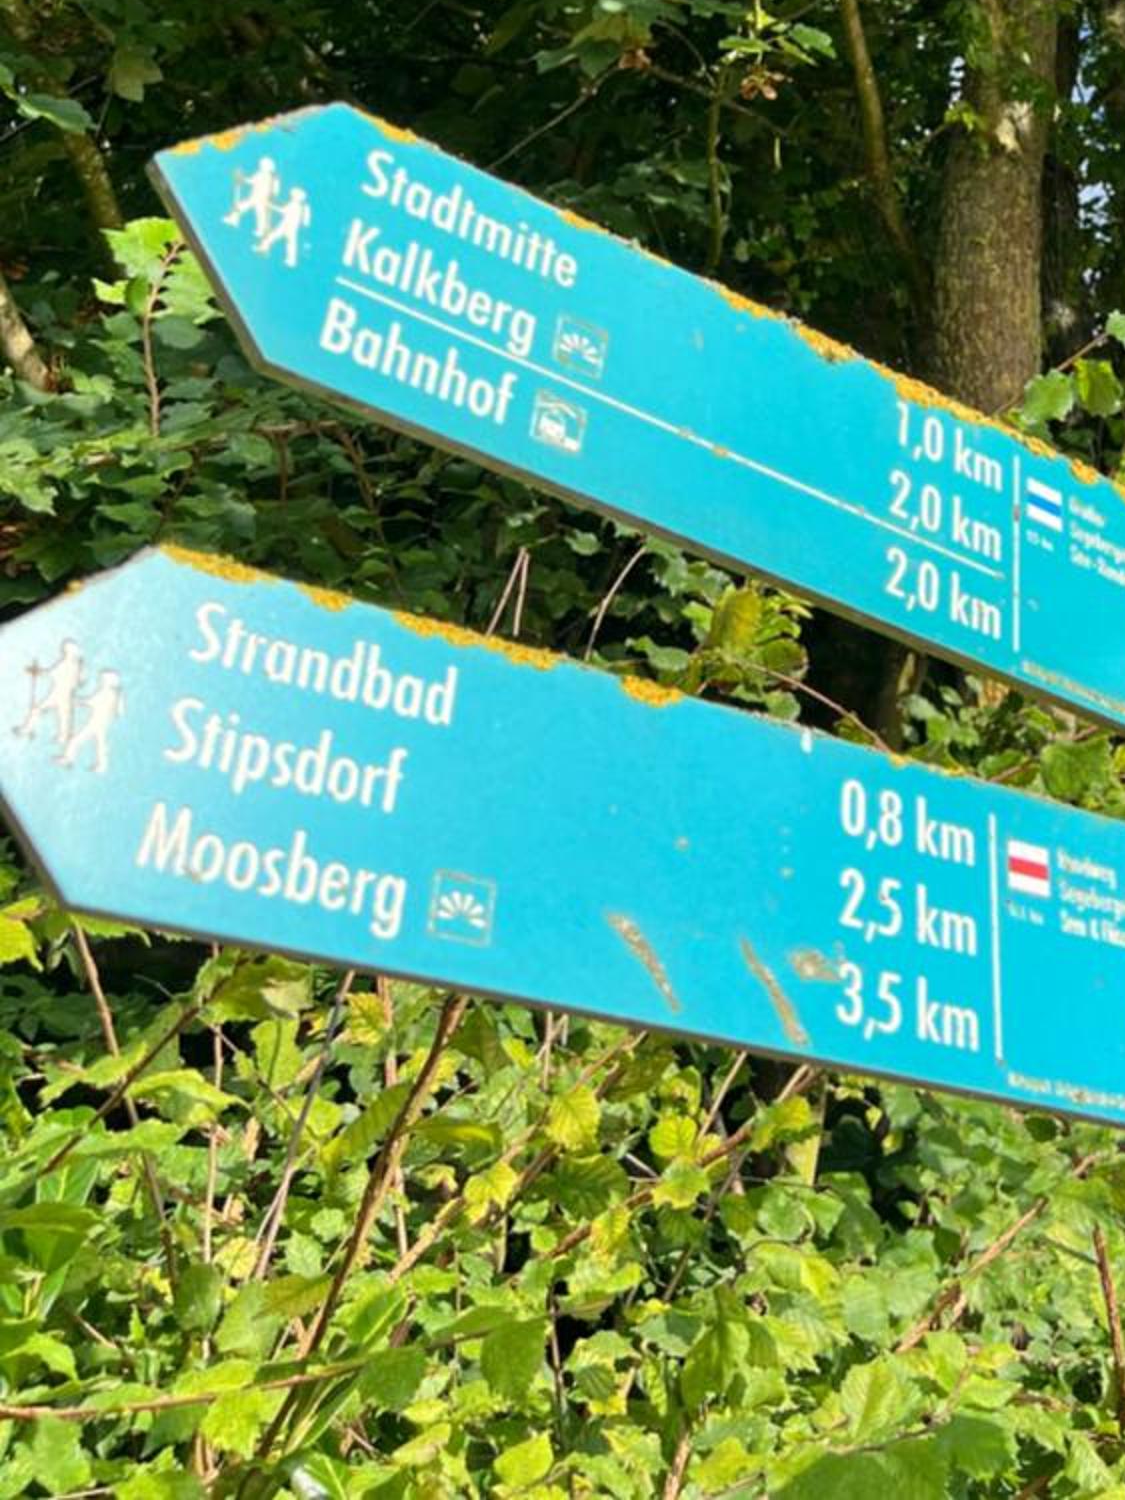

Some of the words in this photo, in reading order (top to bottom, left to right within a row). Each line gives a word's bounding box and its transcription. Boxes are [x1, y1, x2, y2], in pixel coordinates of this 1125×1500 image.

[361, 149, 578, 288] Stadtmitte
[342, 218, 537, 359] Kalkberg
[320, 298, 518, 425] Bahnhof
[896, 400, 944, 463] 1,0
[954, 427, 1002, 492] km
[887, 469, 942, 533] 2,0
[952, 496, 1002, 561] km
[885, 547, 940, 612] 2,0
[950, 571, 1002, 640] km
[189, 601, 459, 726] Strandbad
[163, 697, 408, 813] Stipsdorf
[136, 800, 408, 940] Moosberg
[840, 779, 901, 851] 0,8
[916, 796, 976, 867] km
[838, 867, 902, 943] 2,5
[916, 884, 977, 957] km
[835, 962, 902, 1041] 3,5
[916, 976, 980, 1053] km
